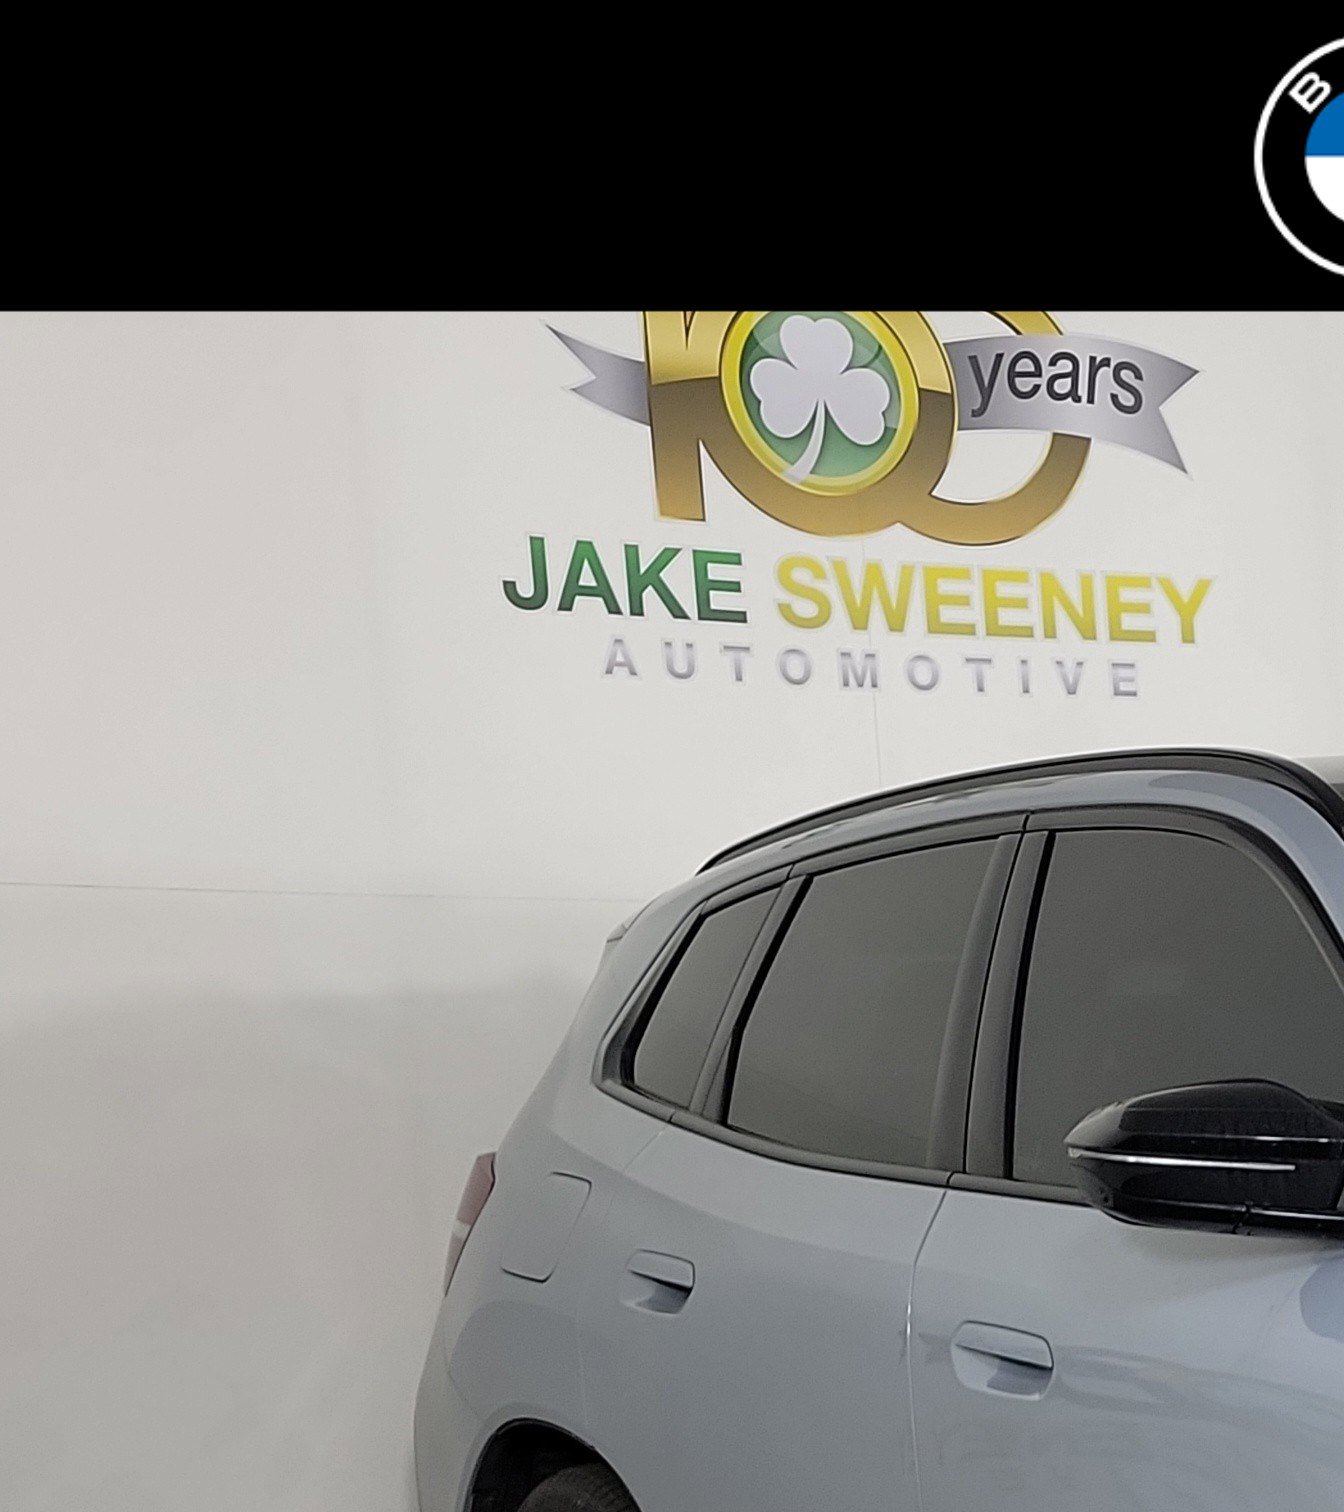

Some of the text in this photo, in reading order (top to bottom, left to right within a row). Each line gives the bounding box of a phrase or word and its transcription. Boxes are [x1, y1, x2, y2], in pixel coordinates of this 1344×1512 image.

[968, 349, 1144, 418] years
[501, 536, 1212, 644] JAKE SWEENEY
[604, 639, 1139, 697] AUTOMOTIVE
